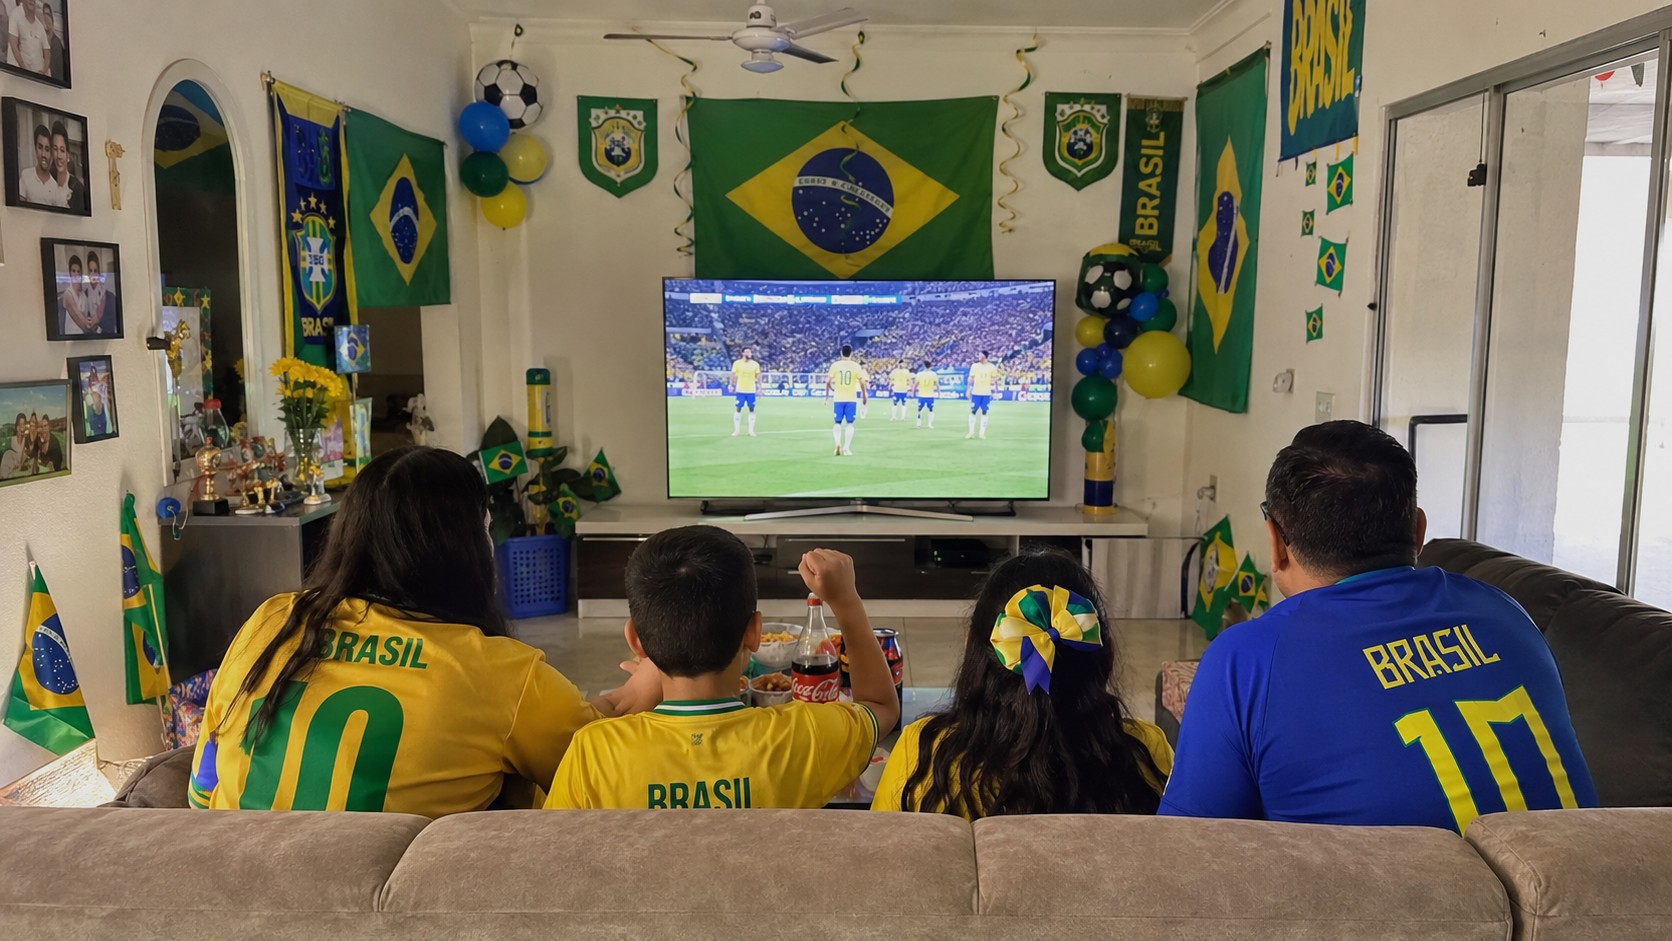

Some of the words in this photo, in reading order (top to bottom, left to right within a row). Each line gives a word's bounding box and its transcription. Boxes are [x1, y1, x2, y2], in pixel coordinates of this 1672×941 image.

[1288, 0, 1355, 136] BRASIL
[1135, 131, 1165, 236] BRASIL
[839, 370, 852, 386] 10
[319, 629, 428, 669] BRASIL
[1362, 624, 1501, 690] BRASIL
[239, 680, 404, 811] 10
[1393, 685, 1579, 838] 10
